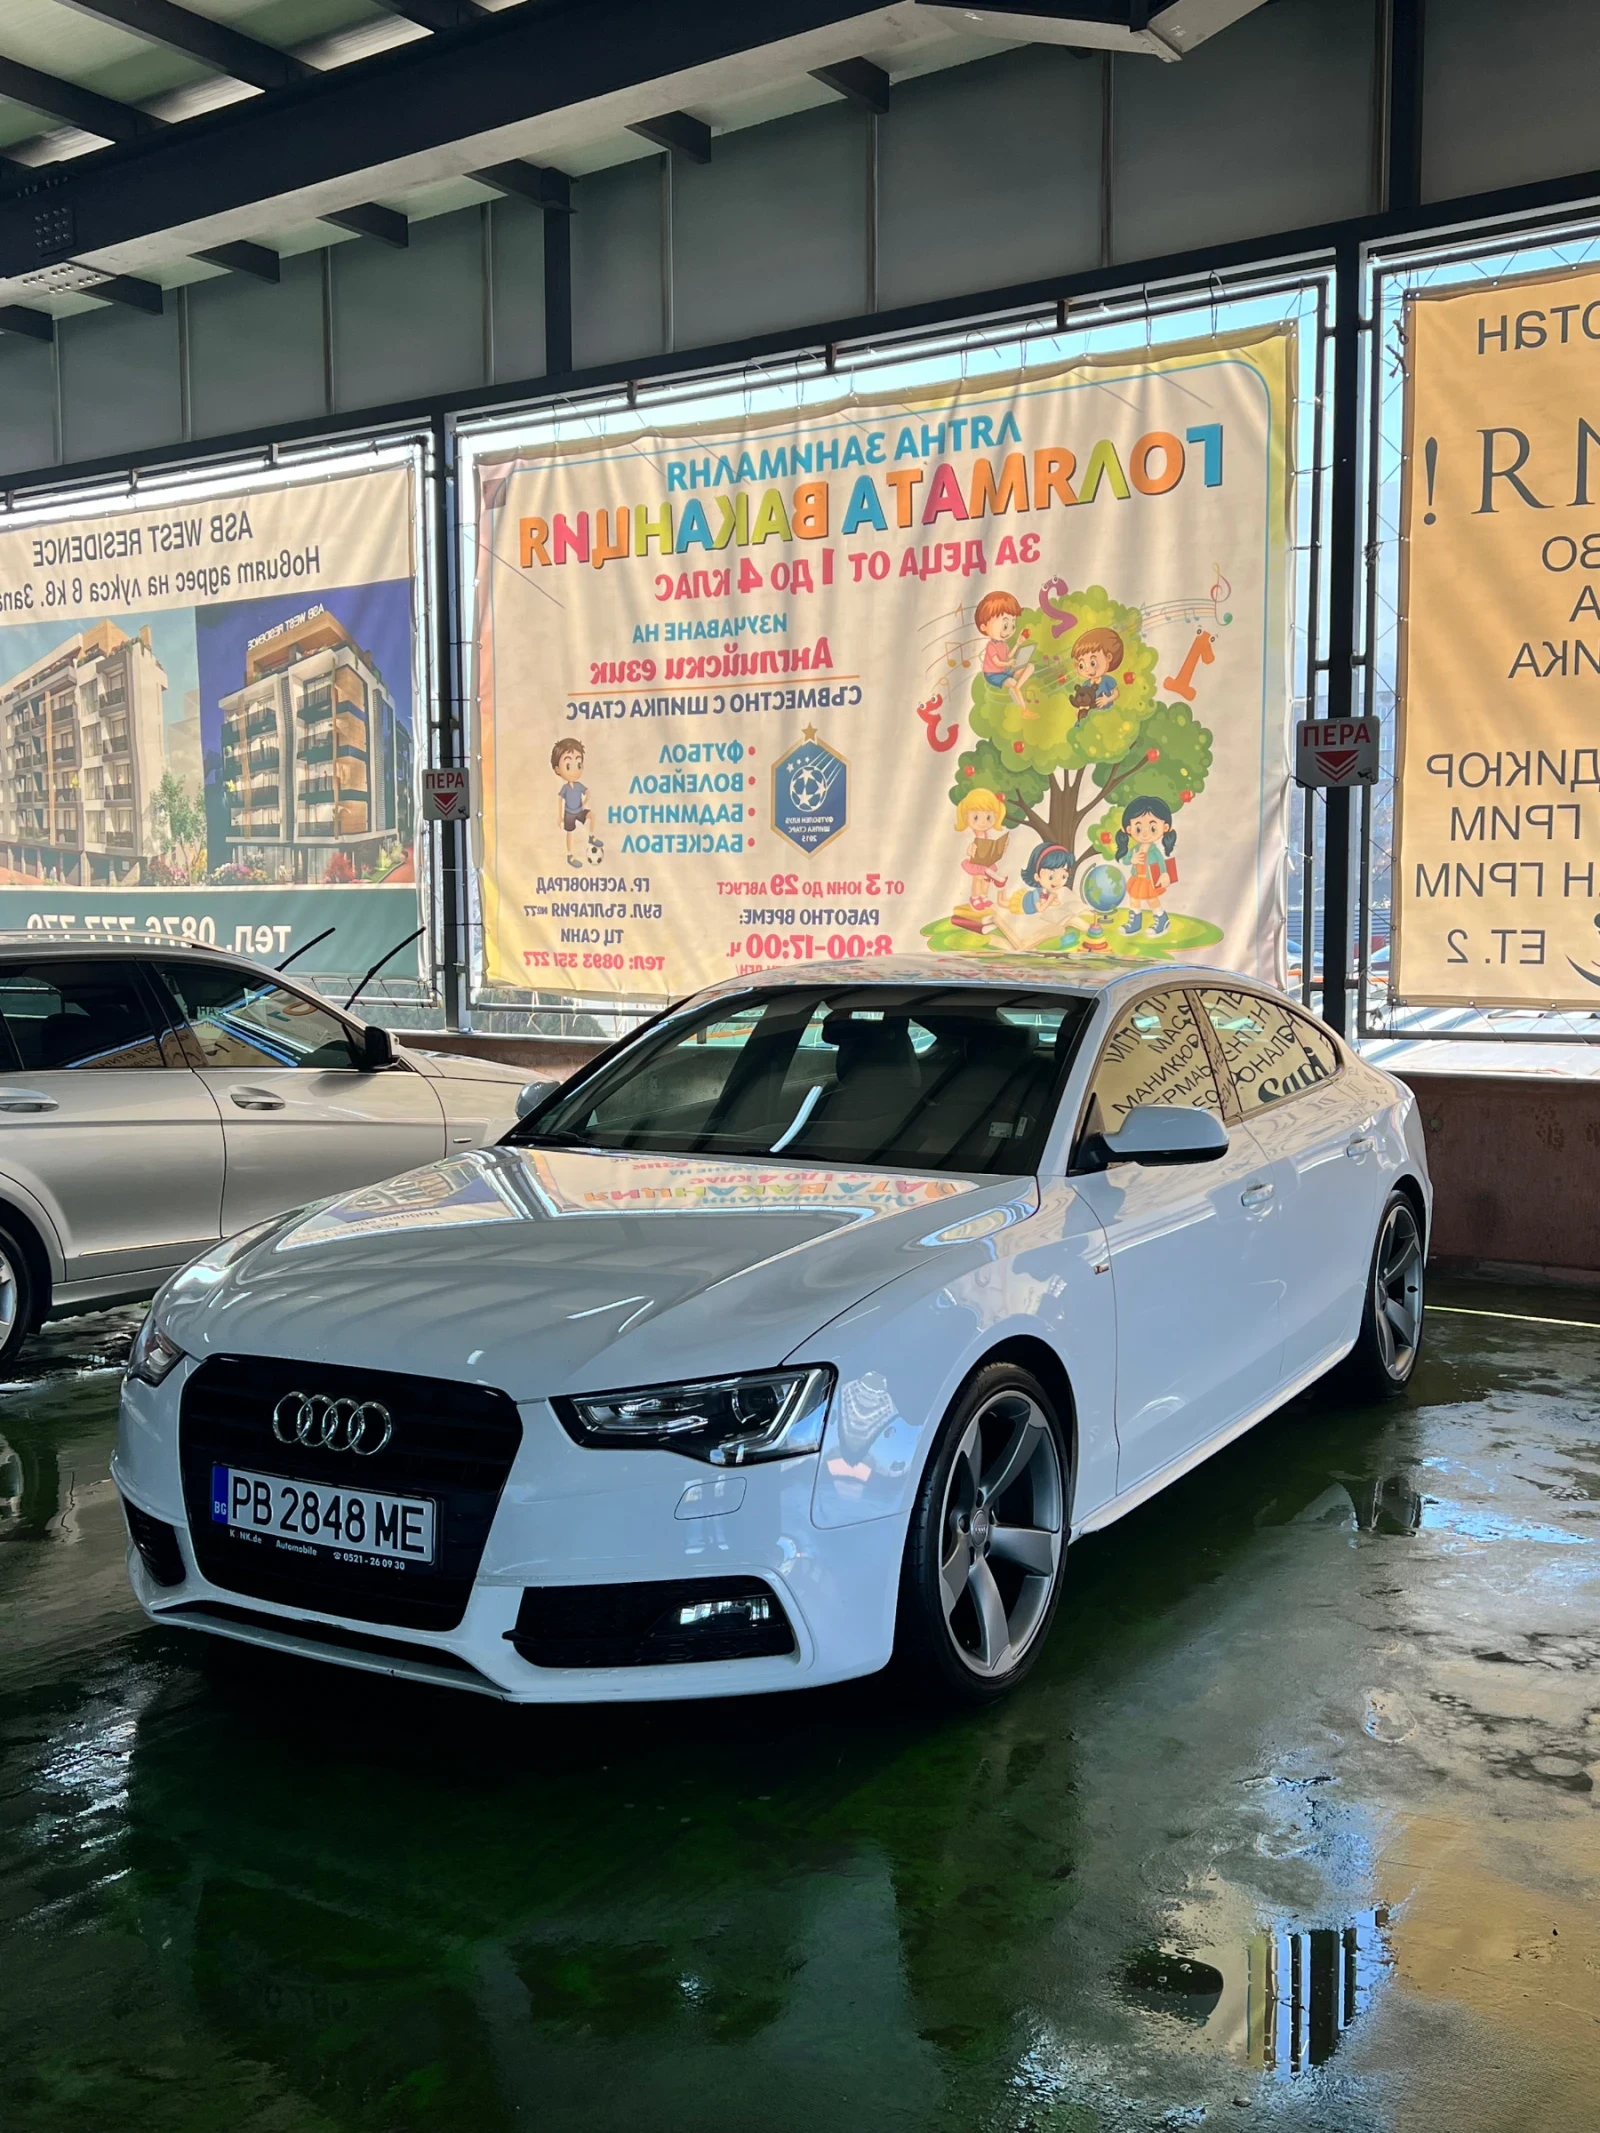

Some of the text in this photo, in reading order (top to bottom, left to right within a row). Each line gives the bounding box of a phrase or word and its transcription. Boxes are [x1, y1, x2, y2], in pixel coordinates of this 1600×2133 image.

[1304, 723, 1371, 747] ПЕРА
[426, 772, 464, 789] ПЕРА
[214, 1501, 227, 1515] BG
[232, 1476, 425, 1554] PB 2848 ME
[276, 1540, 318, 1556] Automobile
[343, 1554, 363, 1564] 0521
[370, 1557, 380, 1567] 26
[382, 1558, 393, 1568] 09
[394, 1560, 406, 1571] 30
